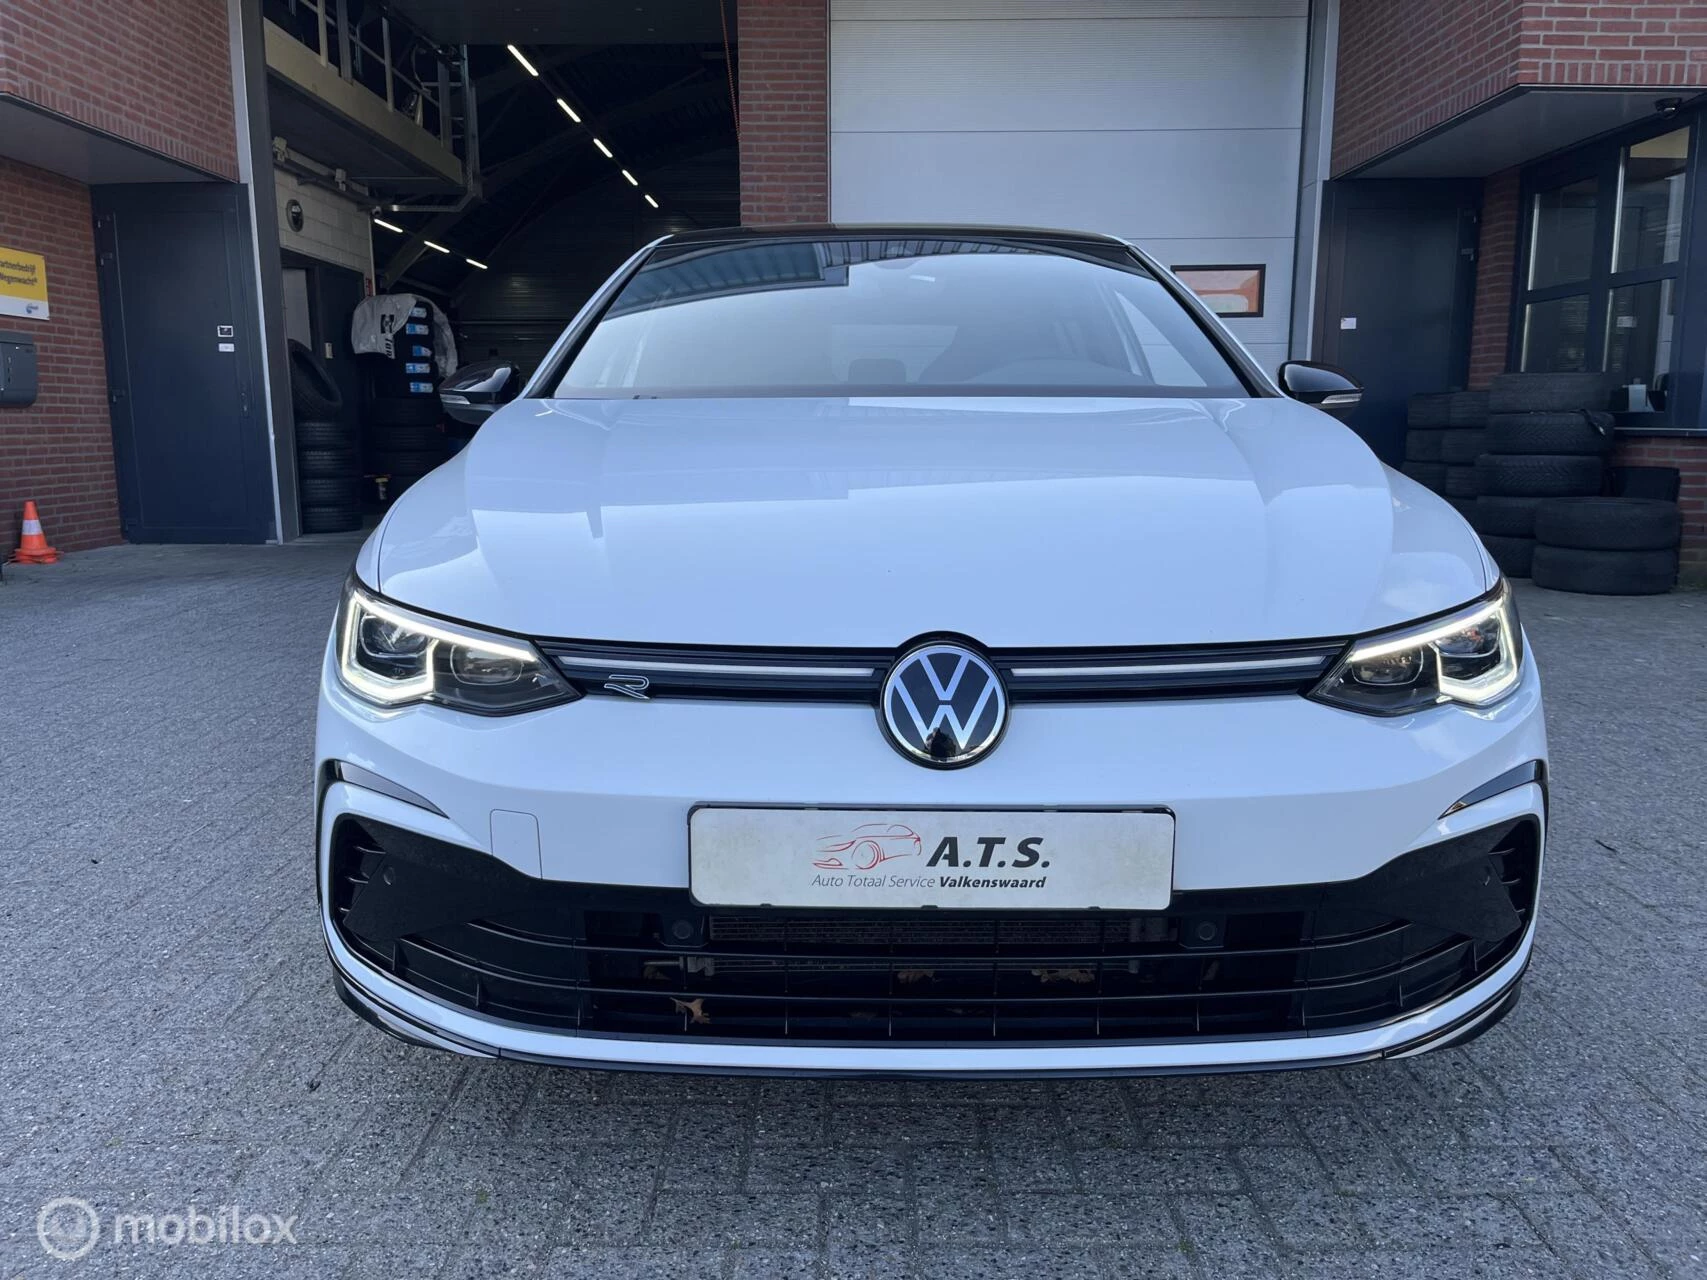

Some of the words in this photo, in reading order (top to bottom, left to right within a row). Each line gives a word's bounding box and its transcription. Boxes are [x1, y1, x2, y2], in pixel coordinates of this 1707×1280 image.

[603, 673, 651, 700] R
[926, 836, 1050, 869] A.T.S.
[811, 874, 844, 888] Auto
[847, 874, 887, 888] Totaal
[888, 874, 936, 888] Service
[939, 875, 1048, 889] Valkenswaard
